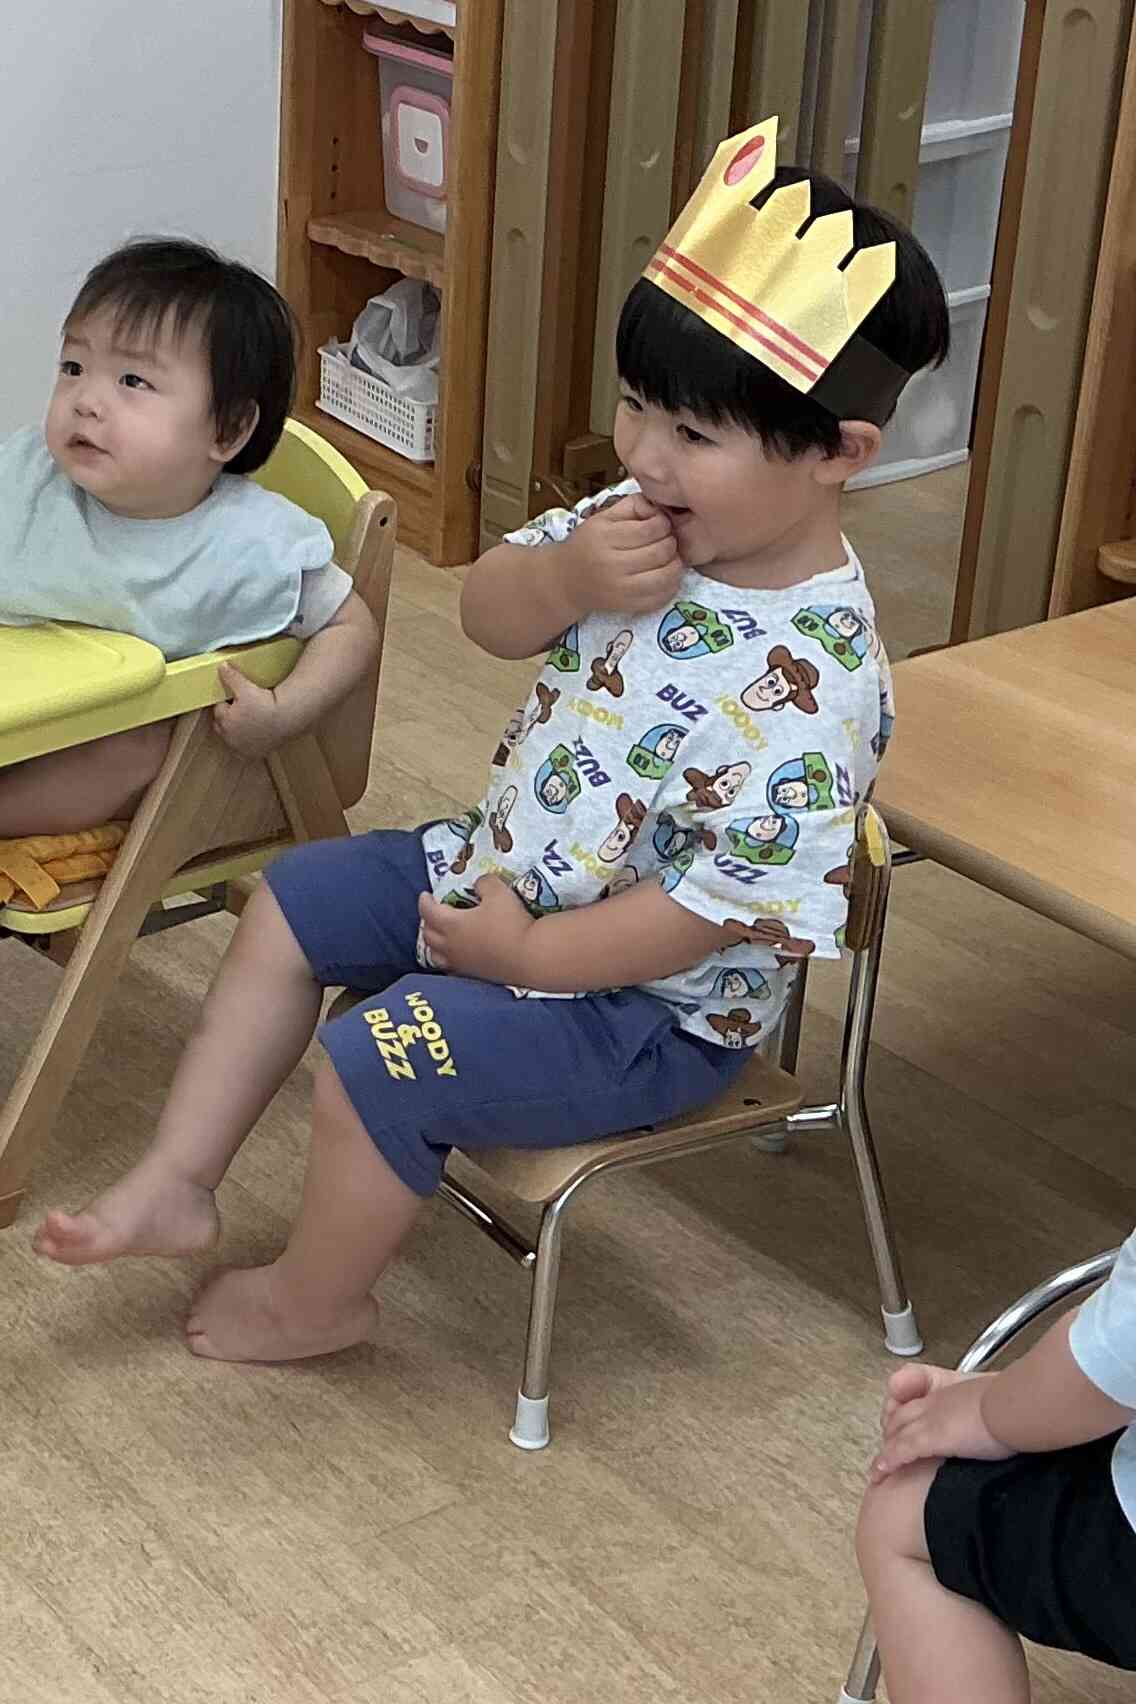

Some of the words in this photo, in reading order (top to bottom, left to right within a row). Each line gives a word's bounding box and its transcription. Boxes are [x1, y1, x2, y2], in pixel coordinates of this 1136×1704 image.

[714, 852, 768, 885] UZZ
[363, 1007, 417, 1080] BUZZ
[397, 1024, 422, 1047] &
[405, 991, 457, 1076] WOODY
